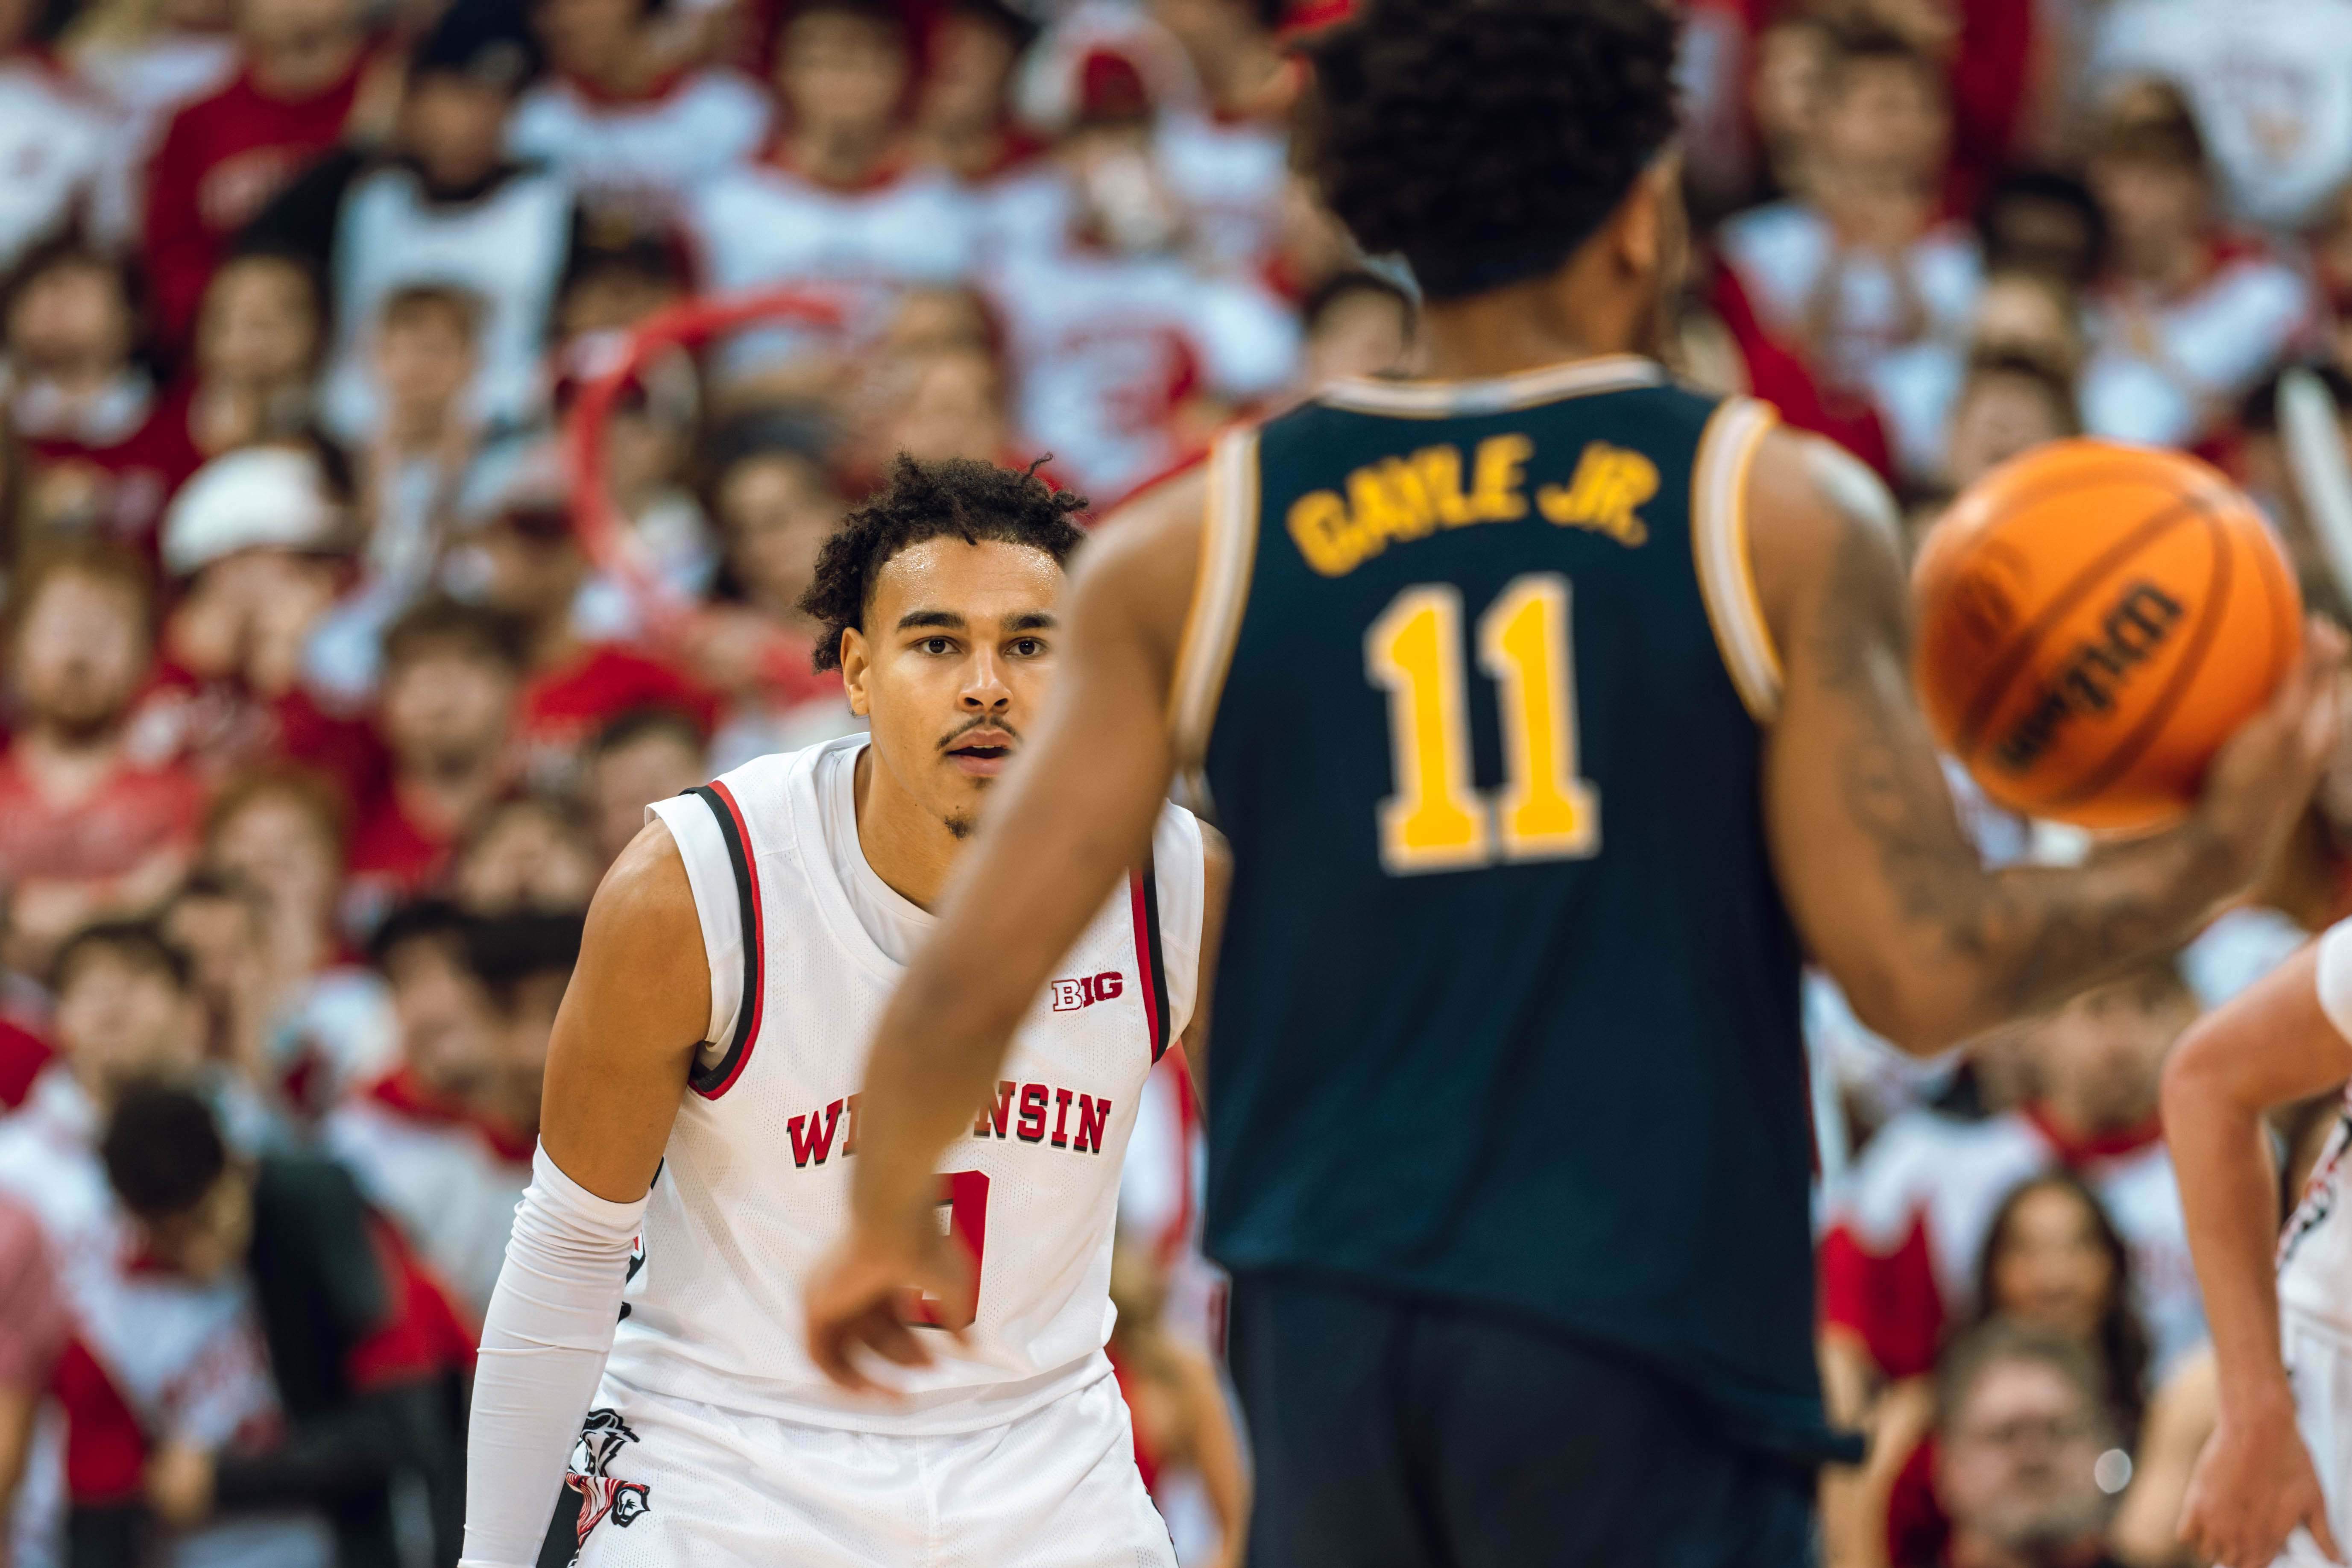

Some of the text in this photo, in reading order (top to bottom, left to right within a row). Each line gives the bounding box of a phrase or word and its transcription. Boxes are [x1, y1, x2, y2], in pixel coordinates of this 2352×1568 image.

[1286, 432, 1534, 577] GAYLE
[1363, 571, 1602, 877] 11
[787, 1081, 1112, 1168] WINSIN
